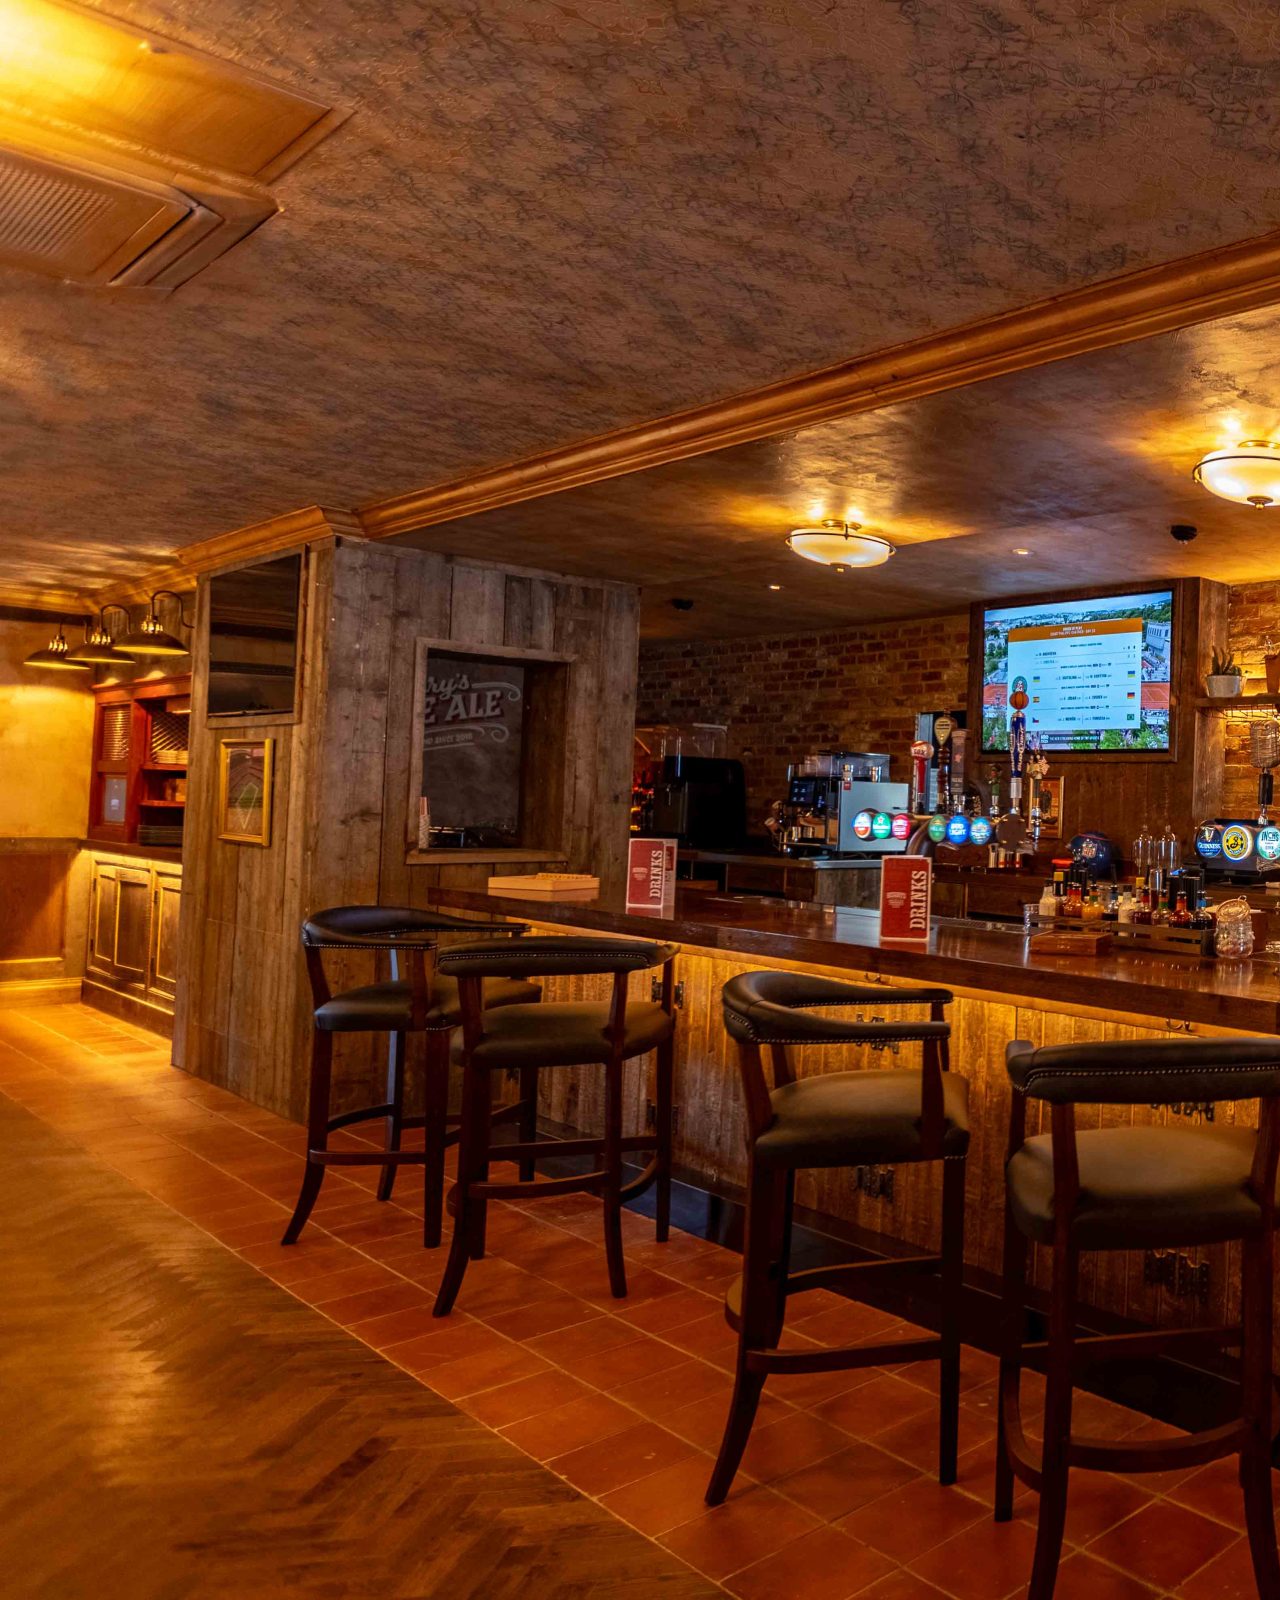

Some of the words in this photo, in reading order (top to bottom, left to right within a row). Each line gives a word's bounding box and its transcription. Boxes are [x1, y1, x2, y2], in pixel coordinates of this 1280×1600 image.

[445, 690, 502, 722] ALE
[649, 850, 663, 898] DRINKS
[910, 871, 928, 929] DRINKS
